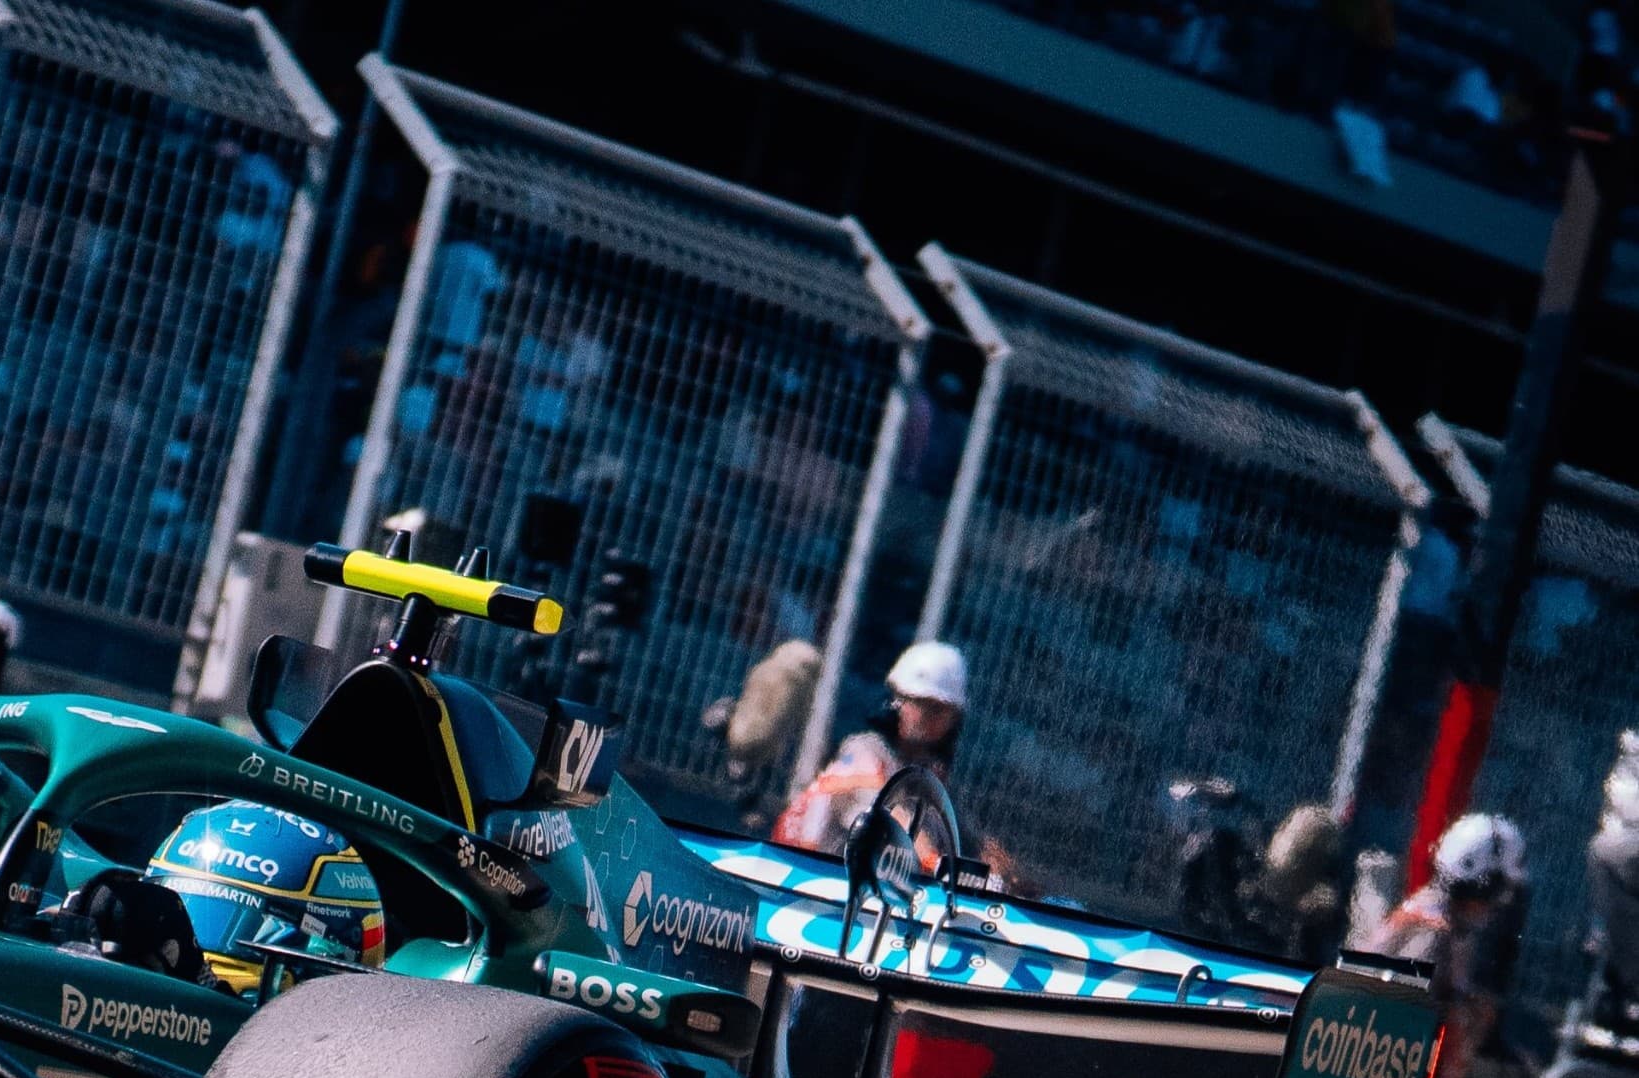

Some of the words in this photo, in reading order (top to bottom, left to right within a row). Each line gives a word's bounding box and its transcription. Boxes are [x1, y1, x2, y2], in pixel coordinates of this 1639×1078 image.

[273, 766, 416, 835] BREITLING
[177, 839, 280, 878] armco
[333, 870, 373, 890] Valvo
[479, 850, 528, 898] Cognition
[208, 885, 262, 909] MARTIN
[652, 893, 751, 956] cognizant
[549, 967, 664, 1020] BOSS
[87, 996, 212, 1046] pepperstone
